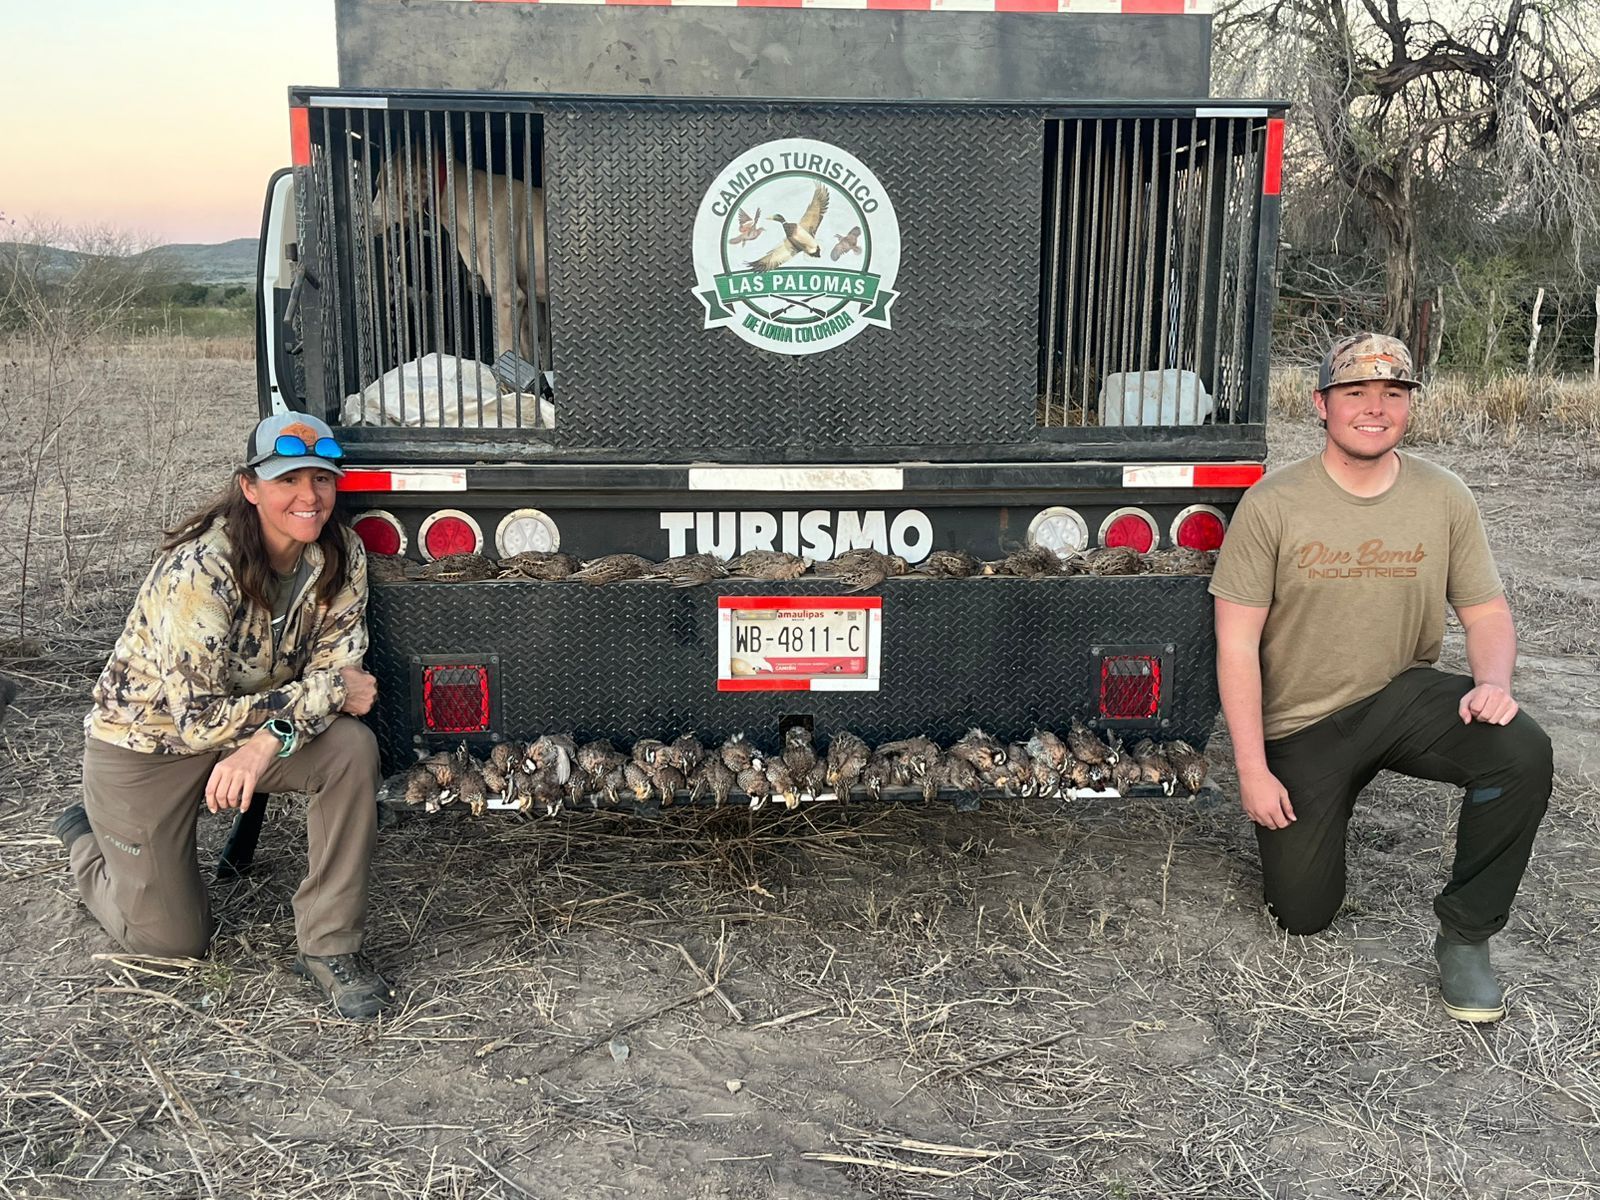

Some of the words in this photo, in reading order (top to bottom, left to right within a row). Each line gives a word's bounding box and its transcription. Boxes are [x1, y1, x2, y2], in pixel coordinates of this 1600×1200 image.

[711, 157, 775, 217] CAMPO
[780, 152, 879, 215] TURISTICO
[728, 275, 764, 295] LAS
[772, 274, 866, 295] PALOMAS
[742, 313, 759, 333] DE
[758, 321, 793, 343] LOMA
[795, 310, 855, 343] COLORADA
[660, 509, 934, 564] TURISMO
[1298, 541, 1352, 569] Dive
[1357, 538, 1427, 566] Bomb
[1308, 567, 1417, 579] INDUSTRIES
[774, 609, 825, 620] amaulipas
[736, 625, 860, 653] WB-4811-C
[115, 841, 141, 856] KUIU
